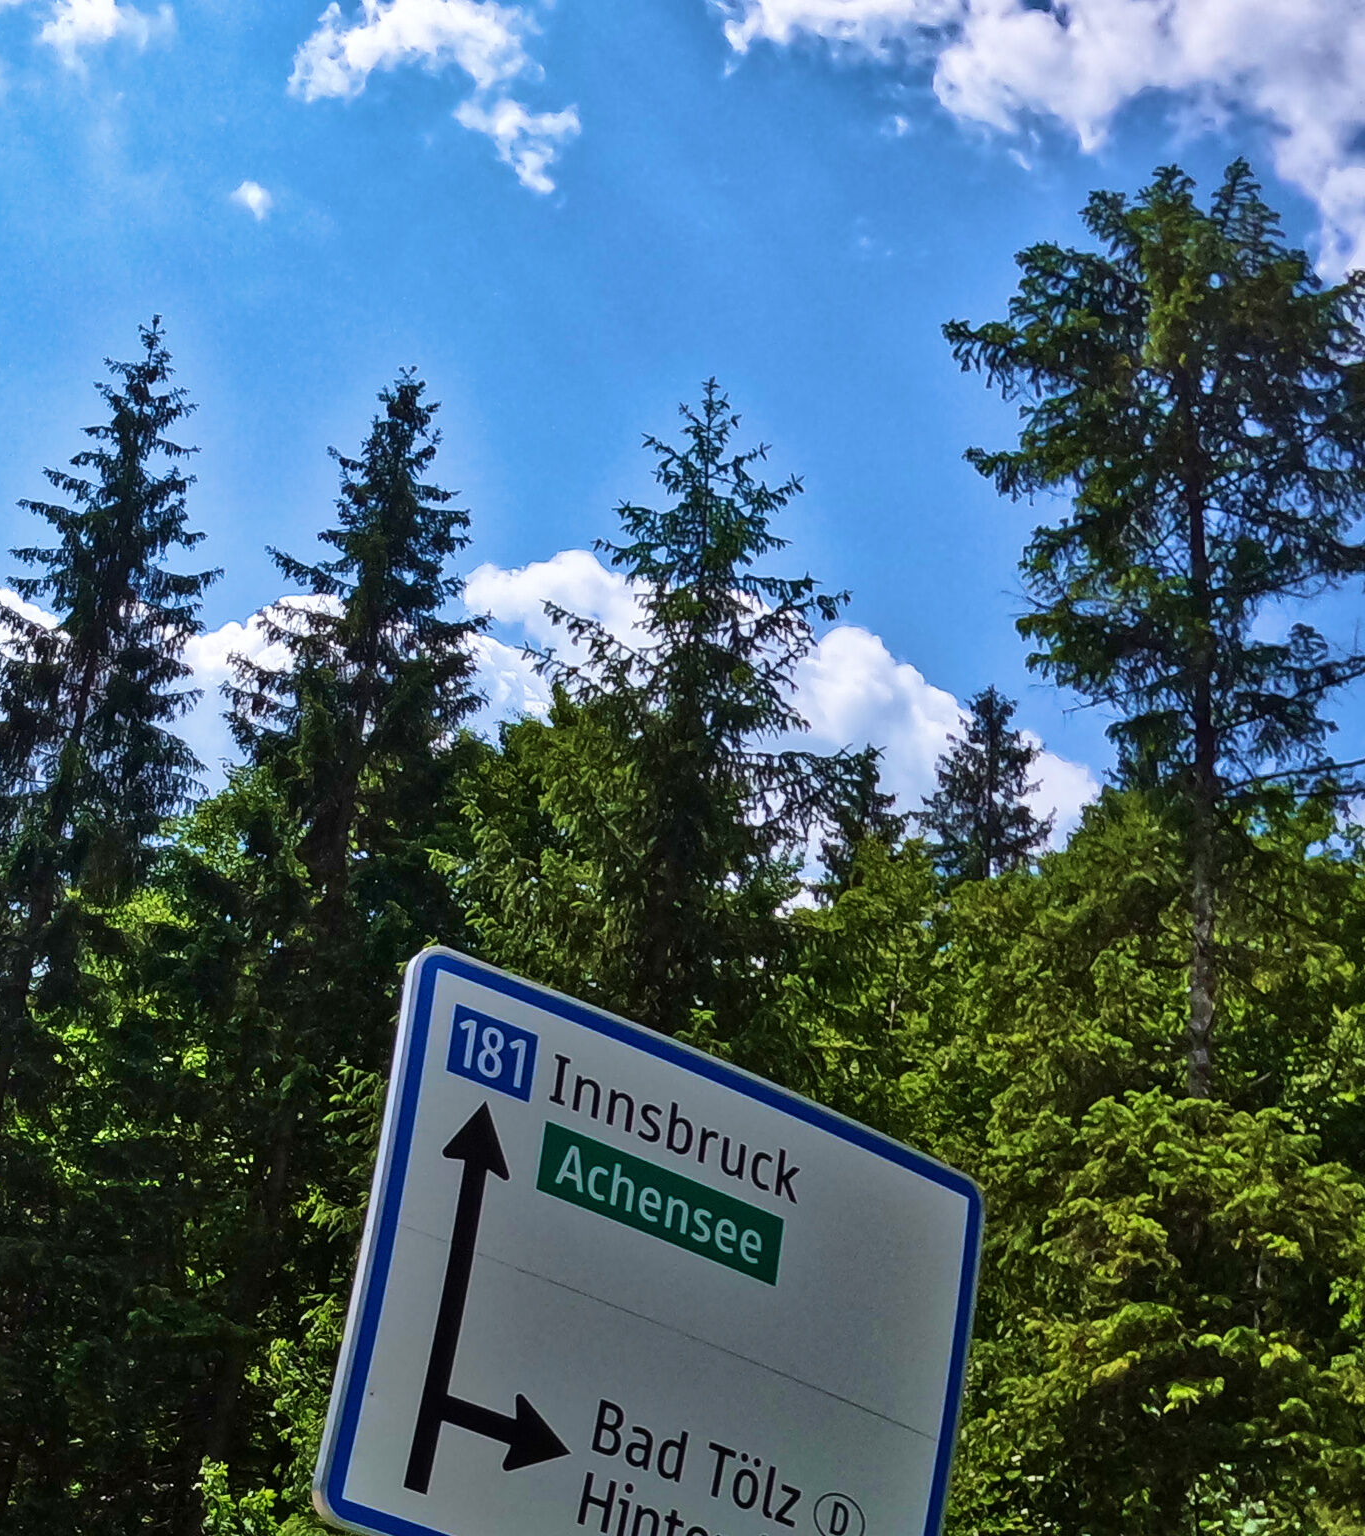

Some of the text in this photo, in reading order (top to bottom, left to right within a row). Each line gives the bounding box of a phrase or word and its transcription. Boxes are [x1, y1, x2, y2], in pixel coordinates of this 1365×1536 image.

[458, 1018, 528, 1089] 181
[549, 1053, 801, 1204] Innsbruck
[554, 1144, 764, 1265] Achensee
[590, 1398, 850, 1536] Bad Tölz D
